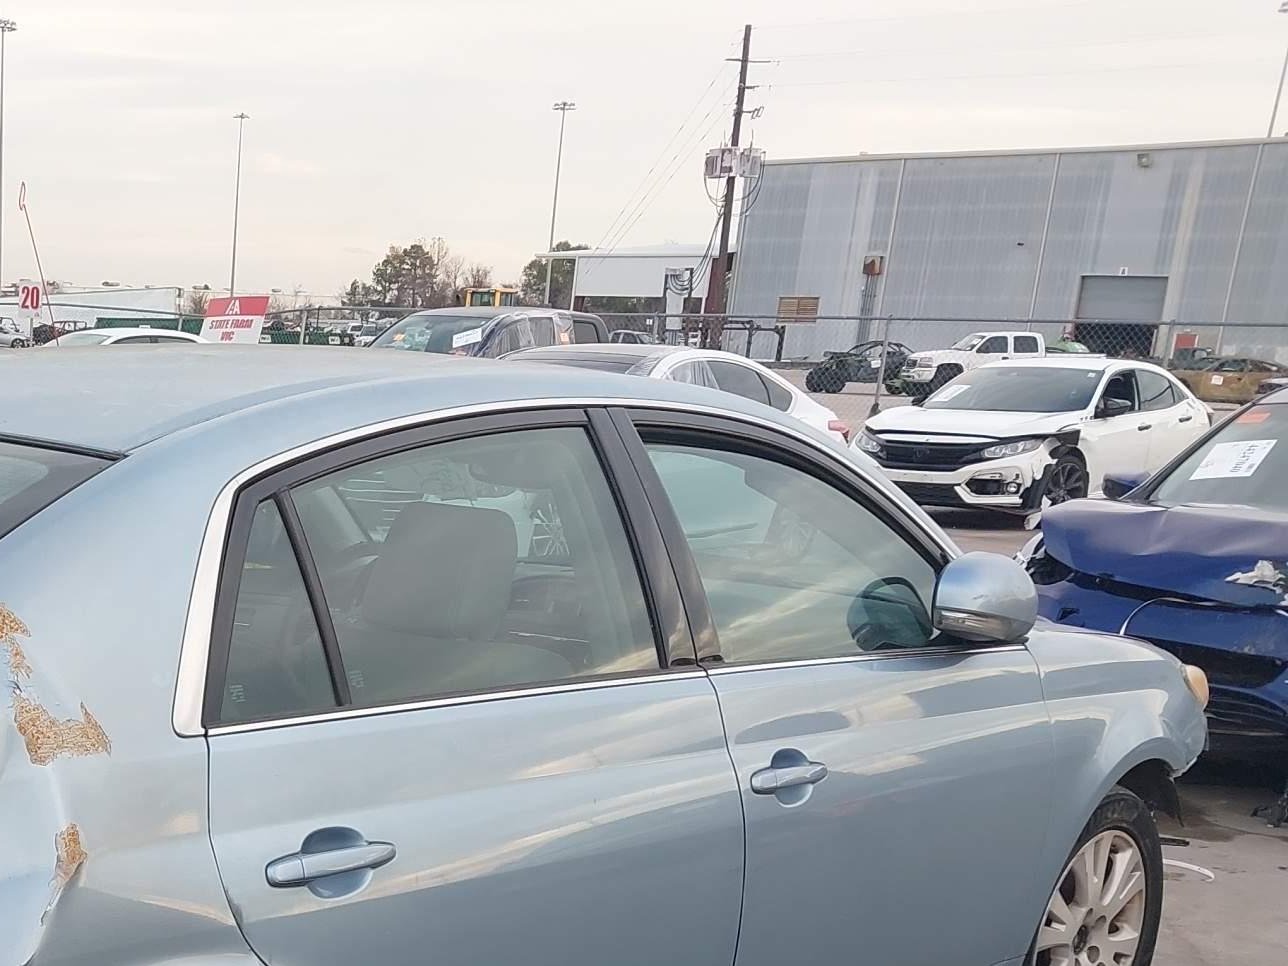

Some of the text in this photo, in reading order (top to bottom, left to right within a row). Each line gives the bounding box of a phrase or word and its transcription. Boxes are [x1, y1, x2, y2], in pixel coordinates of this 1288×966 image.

[21, 286, 40, 309] 20
[209, 319, 254, 329] STATE FARM
